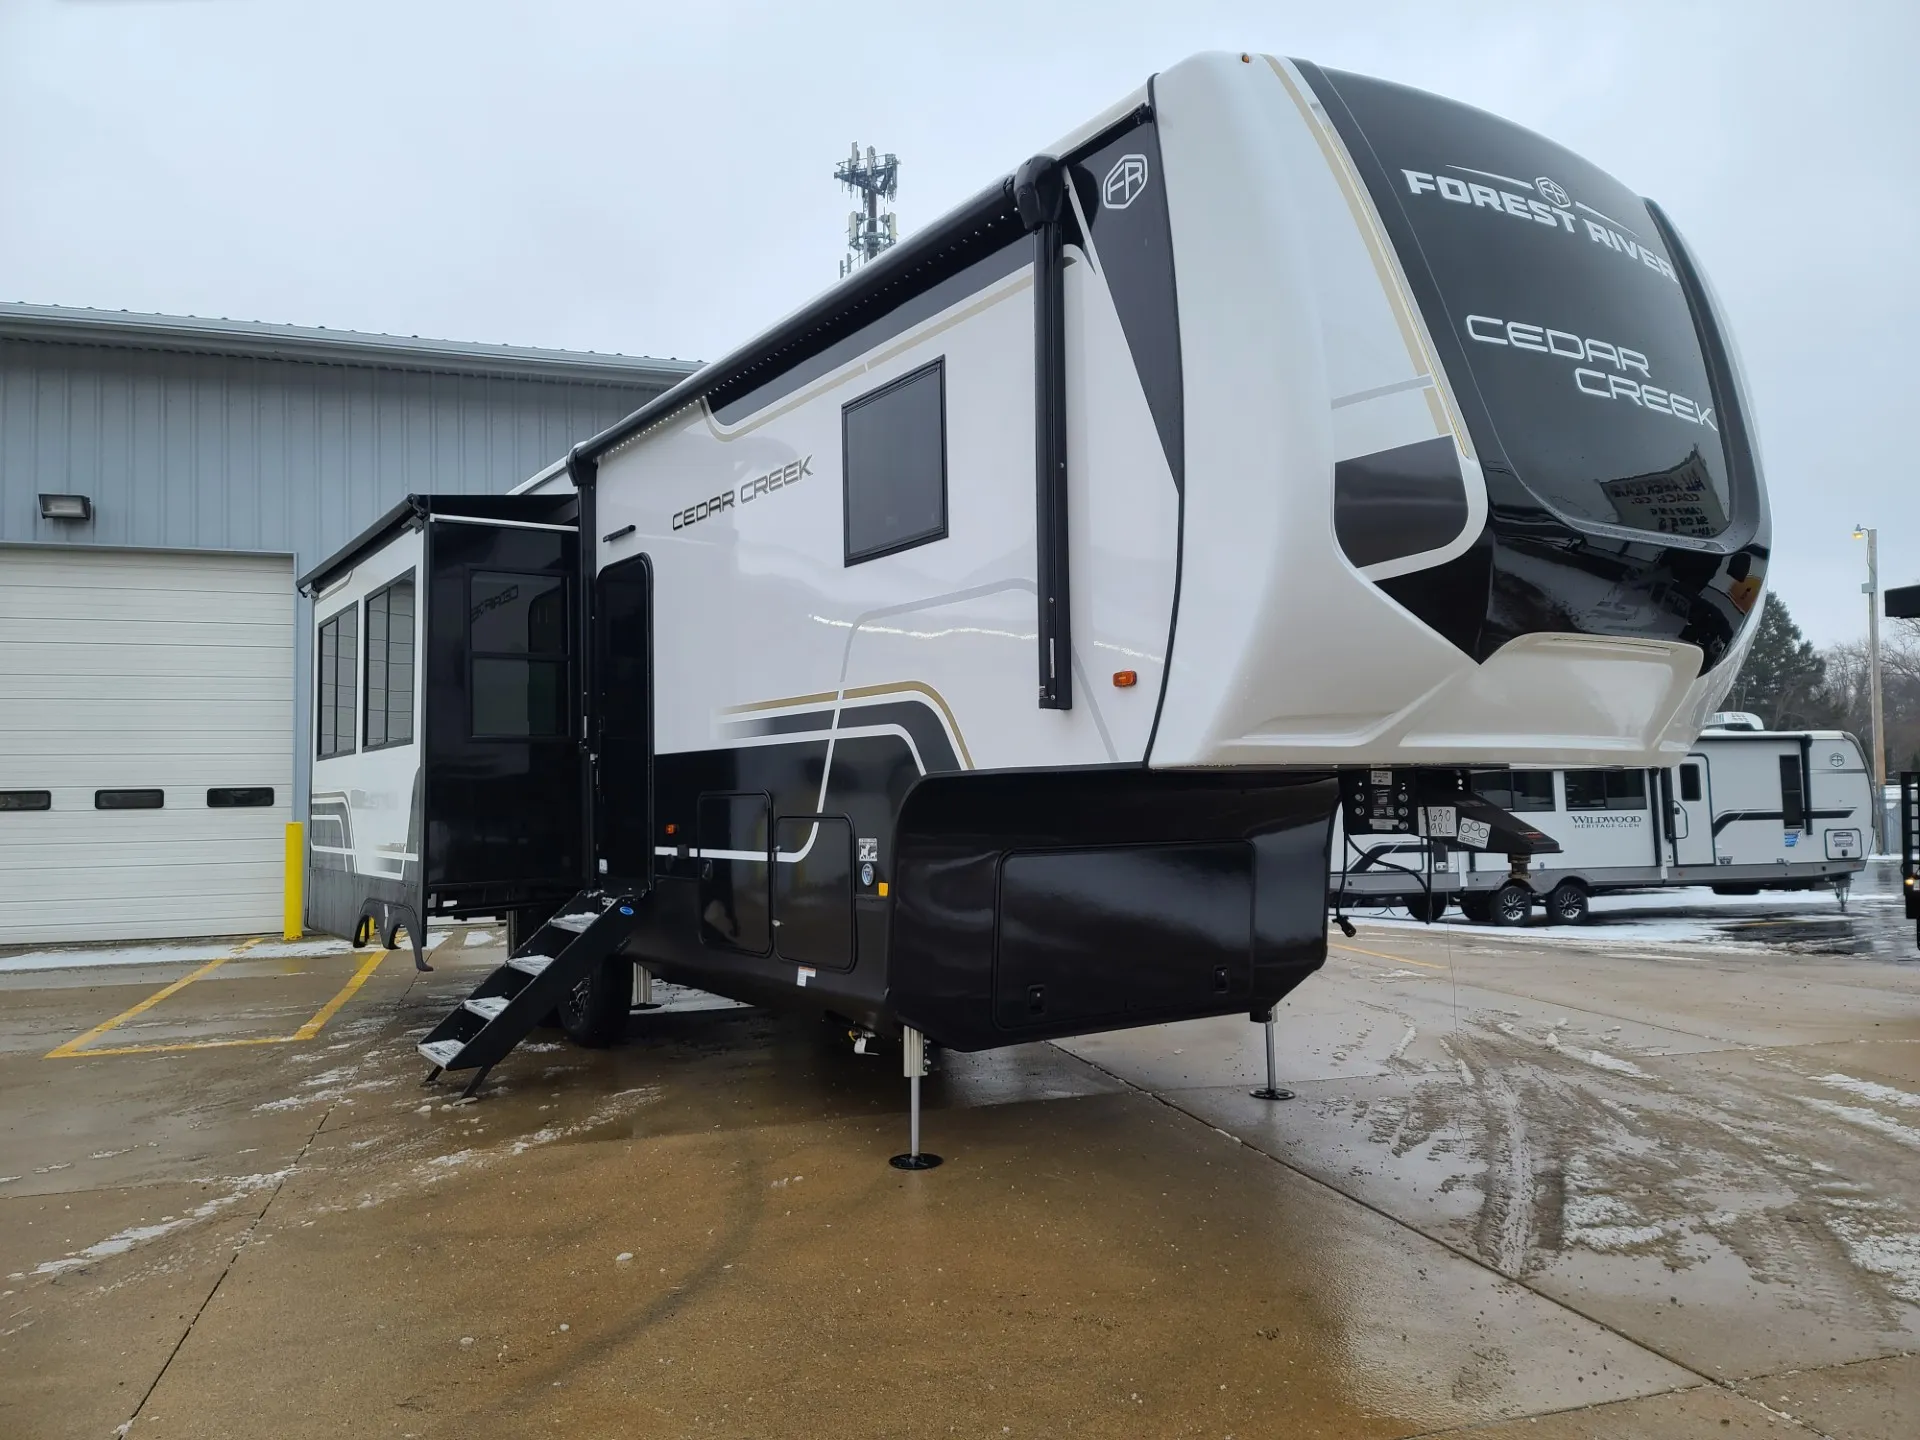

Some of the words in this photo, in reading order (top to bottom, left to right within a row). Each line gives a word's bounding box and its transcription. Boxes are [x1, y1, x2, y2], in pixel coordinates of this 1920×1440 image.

[1400, 168, 1576, 233] FOREST
[1582, 218, 1680, 284] RIVER
[1465, 314, 1652, 378] CEDAR
[1574, 367, 1718, 431] CREEK
[672, 489, 736, 531] CEDAR
[740, 454, 814, 504] CREEK
[1422, 808, 1451, 822] 630
[1570, 815, 1642, 824] WILDWOOD
